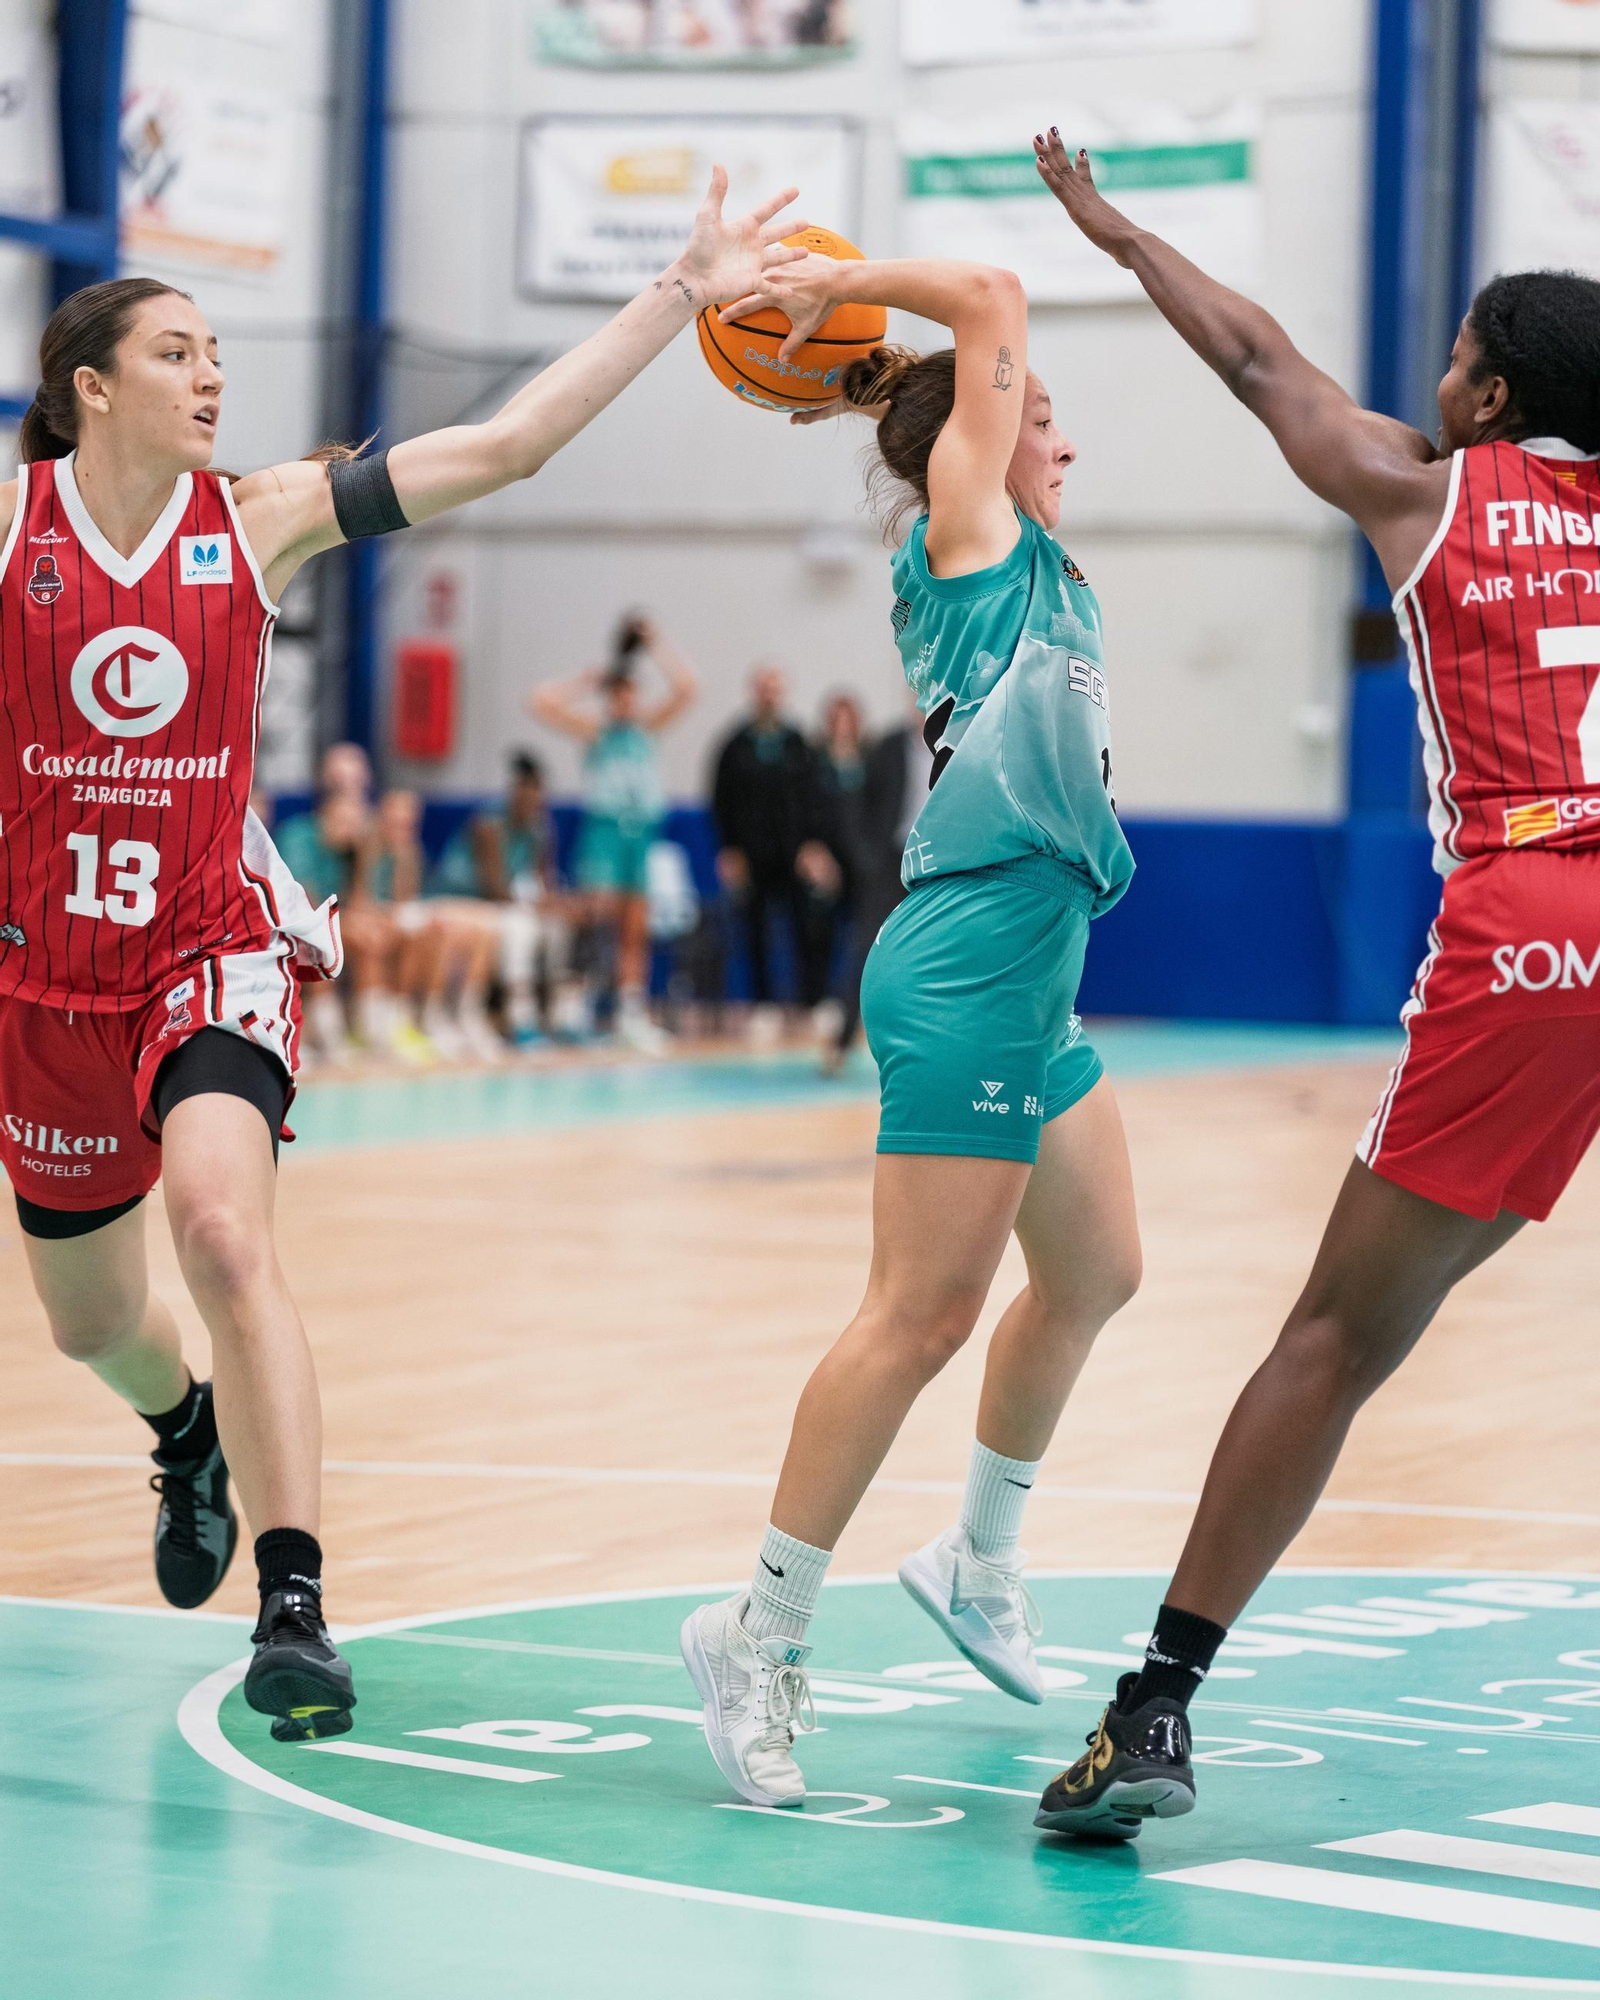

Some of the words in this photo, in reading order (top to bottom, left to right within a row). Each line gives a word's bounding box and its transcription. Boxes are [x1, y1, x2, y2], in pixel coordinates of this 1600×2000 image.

[744, 347, 822, 380] endesa
[29, 536, 69, 545] MERCURY
[1461, 576, 1515, 607] AIR
[1526, 568, 1600, 597] HO
[22, 743, 232, 780] Casademont
[72, 784, 173, 807] ZARAGOZA
[65, 831, 160, 927] 13
[971, 1099, 1010, 1114] vive
[4, 1114, 119, 1155] Silken
[21, 1155, 92, 1177] HOTELES
